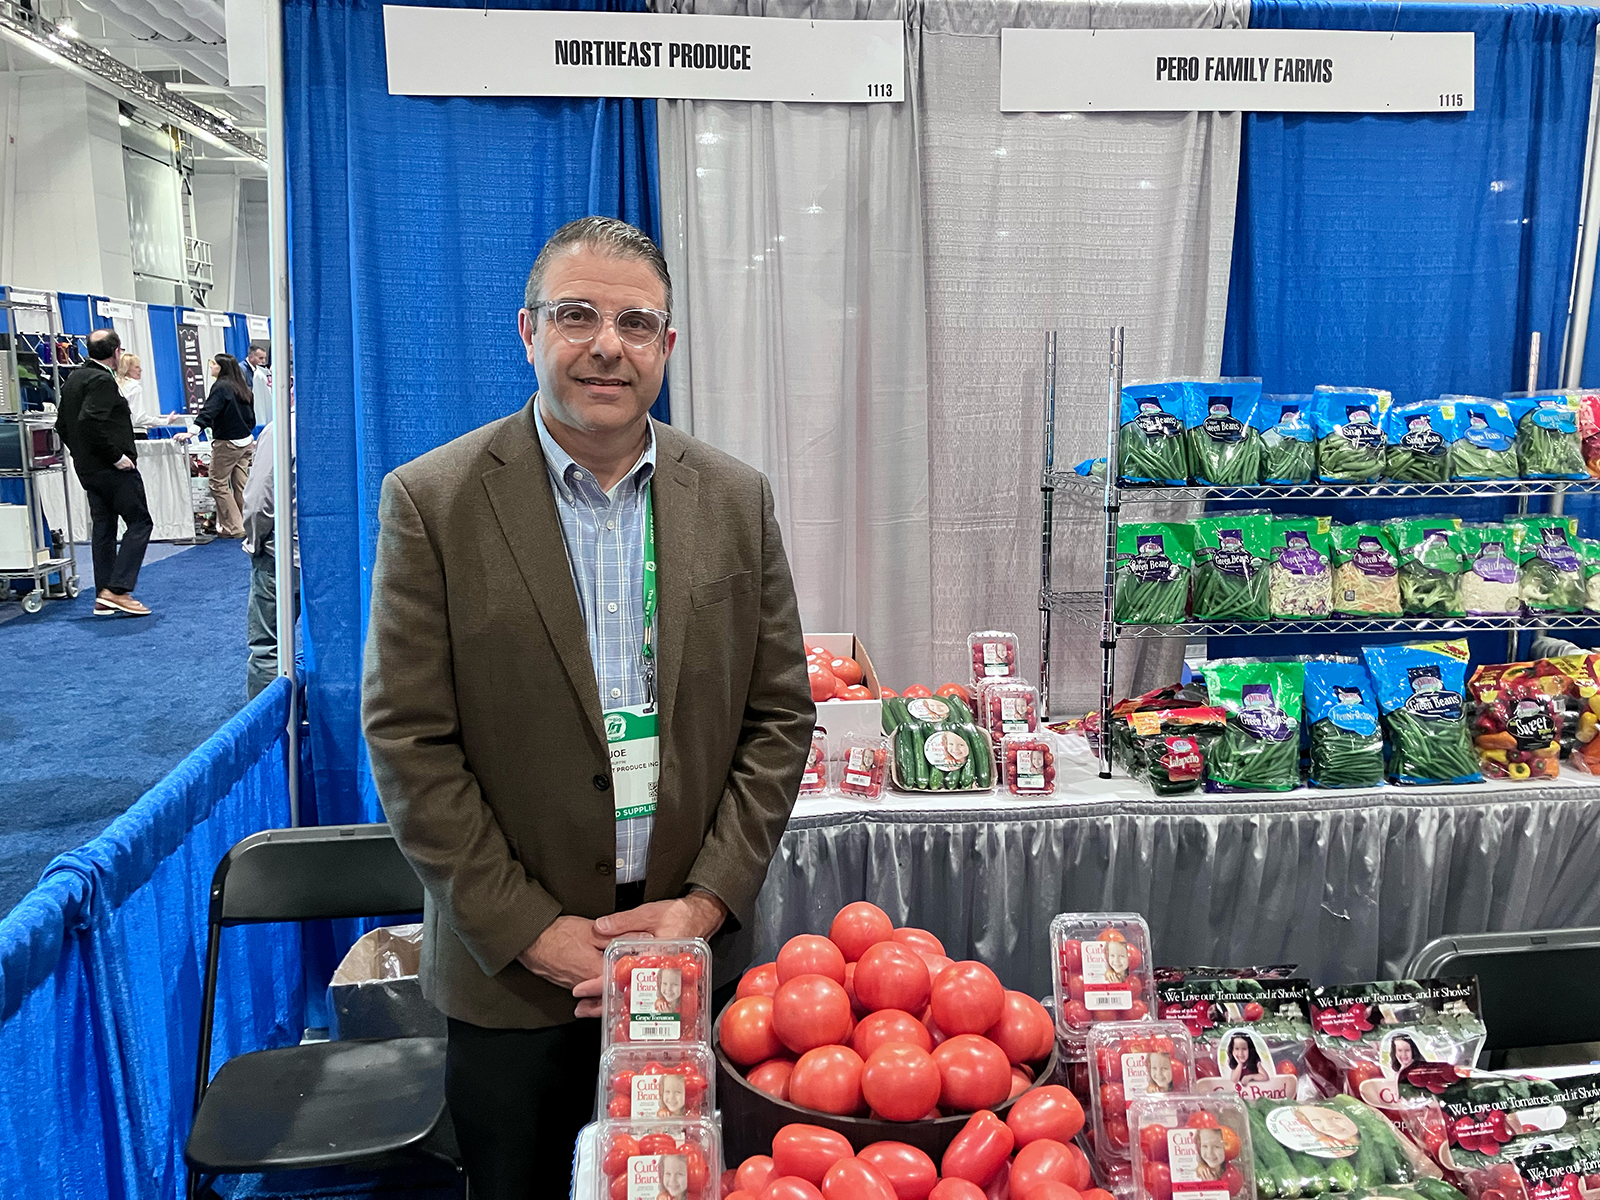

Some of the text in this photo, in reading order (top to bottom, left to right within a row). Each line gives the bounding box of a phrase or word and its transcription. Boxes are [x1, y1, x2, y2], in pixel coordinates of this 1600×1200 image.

[555, 39, 751, 71] NORTHEAST PRODUCE
[1156, 56, 1333, 84] PERO FAMILY FARMS
[867, 82, 893, 98] 1113
[1438, 93, 1464, 107] 1115
[1221, 421, 1240, 431] Beans
[1409, 695, 1460, 711] Green Beans
[1239, 713, 1262, 727] Green
[1515, 715, 1548, 736] Sweet
[610, 748, 627, 759] JOE
[1169, 752, 1200, 769] Jalapeño
[616, 762, 647, 774] PRODUCE
[647, 760, 659, 768] INC
[1164, 988, 1305, 1003] We Love our Tomatoes, and it Shows!
[1316, 986, 1472, 1009] We Love our Tomatoes, and it Shows!
[635, 1014, 651, 1022] Grape
[1249, 1083, 1287, 1100] Brand
[1448, 1103, 1469, 1117] We
[1468, 1101, 1491, 1114] Love
[1491, 1100, 1508, 1111] our
[1507, 1095, 1554, 1109] Tomatoes,
[1553, 1089, 1570, 1102] and
[1570, 1088, 1578, 1101] it
[1527, 1167, 1546, 1182] We
[1544, 1165, 1565, 1179] Love
